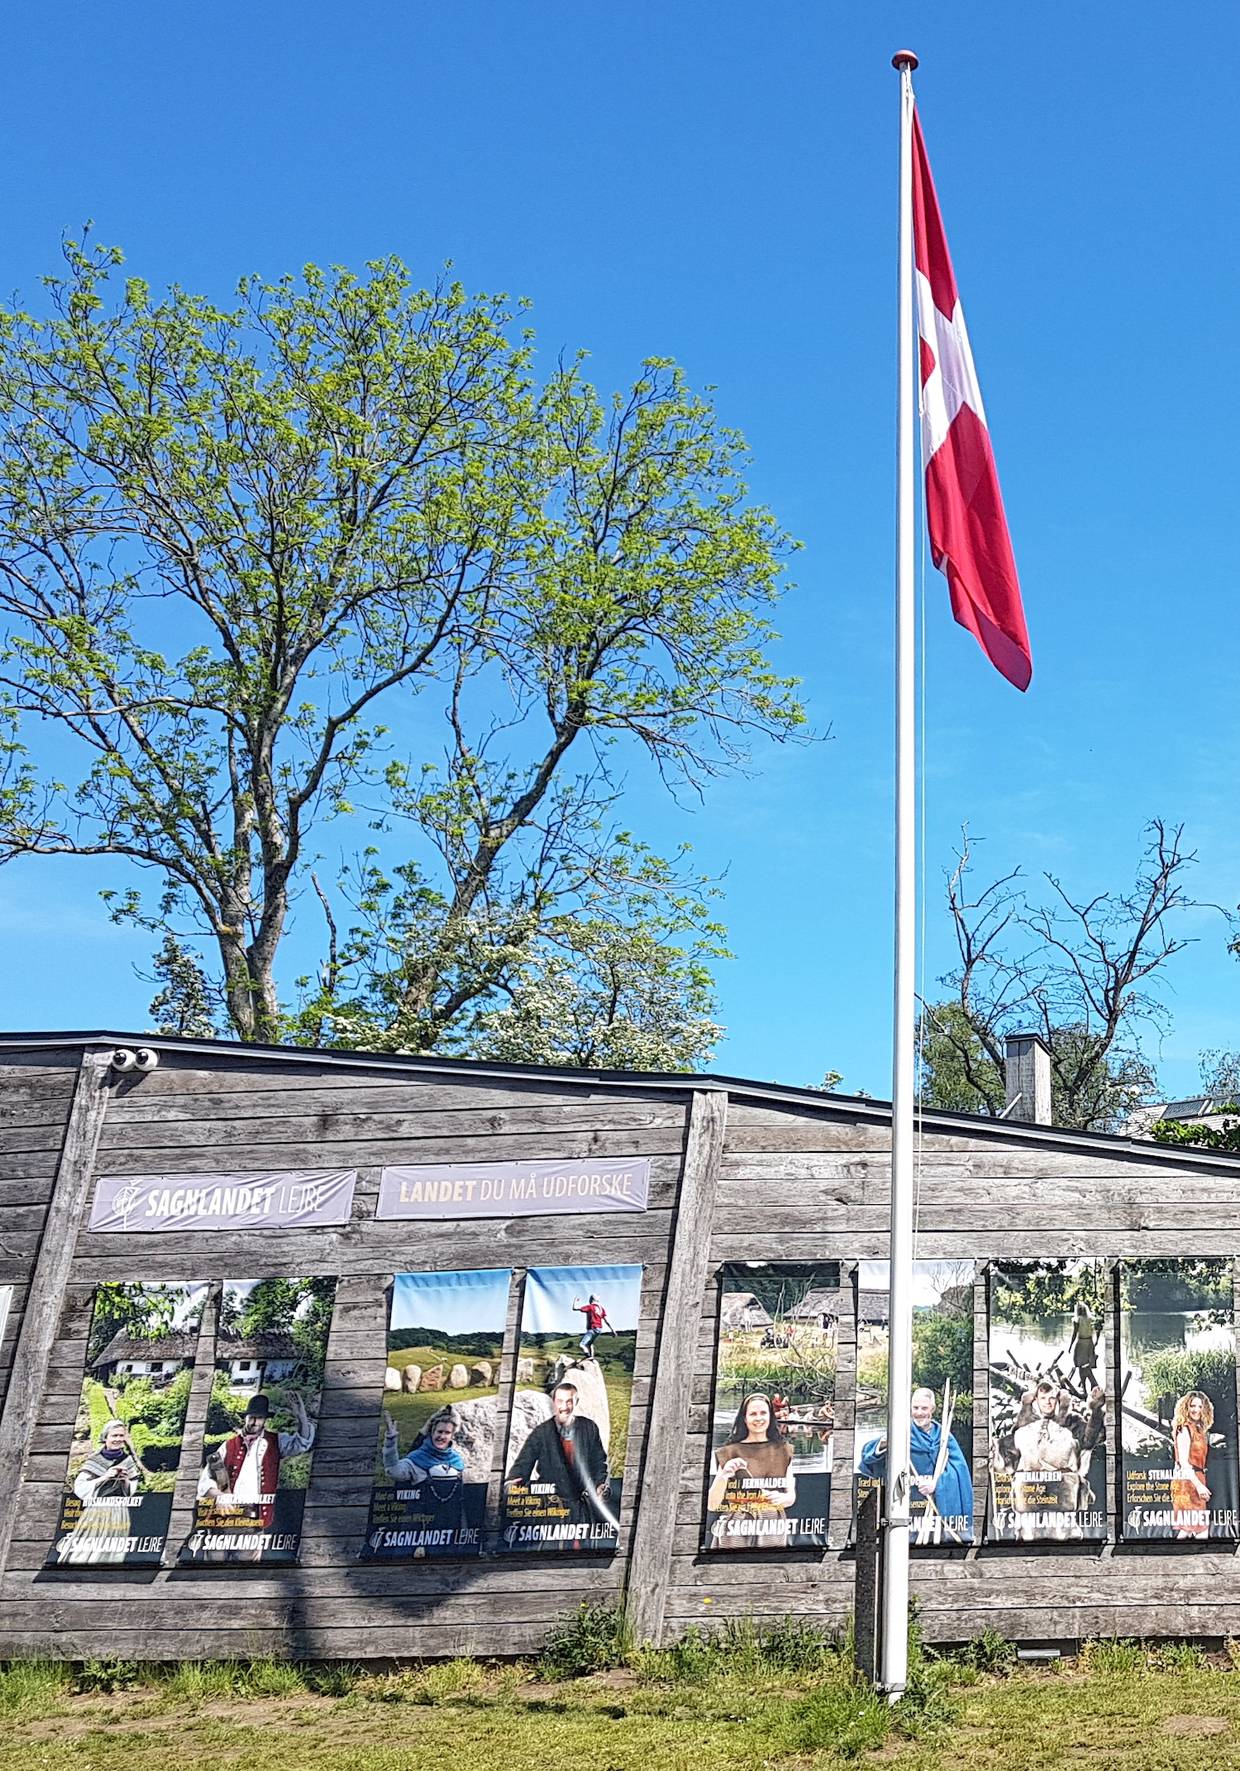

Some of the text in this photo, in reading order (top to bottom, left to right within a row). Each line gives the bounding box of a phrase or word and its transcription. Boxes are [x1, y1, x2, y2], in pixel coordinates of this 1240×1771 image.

[400, 1172, 632, 1203] LANDET DU MÅ UDFORSKE
[145, 1185, 324, 1217] SAGNLANDET LEJRE
[1127, 1470, 1147, 1480] Udforsk
[396, 1489, 421, 1500] VIKING
[530, 1483, 556, 1494] VIKING
[942, 1515, 968, 1532] LEJRE
[1007, 1511, 1103, 1528] SAGNLANDET LEJRE
[1143, 1509, 1237, 1526] SAGNLANDET LEJRE
[519, 1522, 616, 1541] SAGNLANDET LEJRE
[726, 1518, 825, 1536] SAGNLANDET LEJRE
[70, 1536, 164, 1553] SAGNLANDET LEJRE
[202, 1533, 298, 1551] SAGNLANDET LEJRE
[383, 1528, 480, 1547] SAGNLANDET LEJRE
